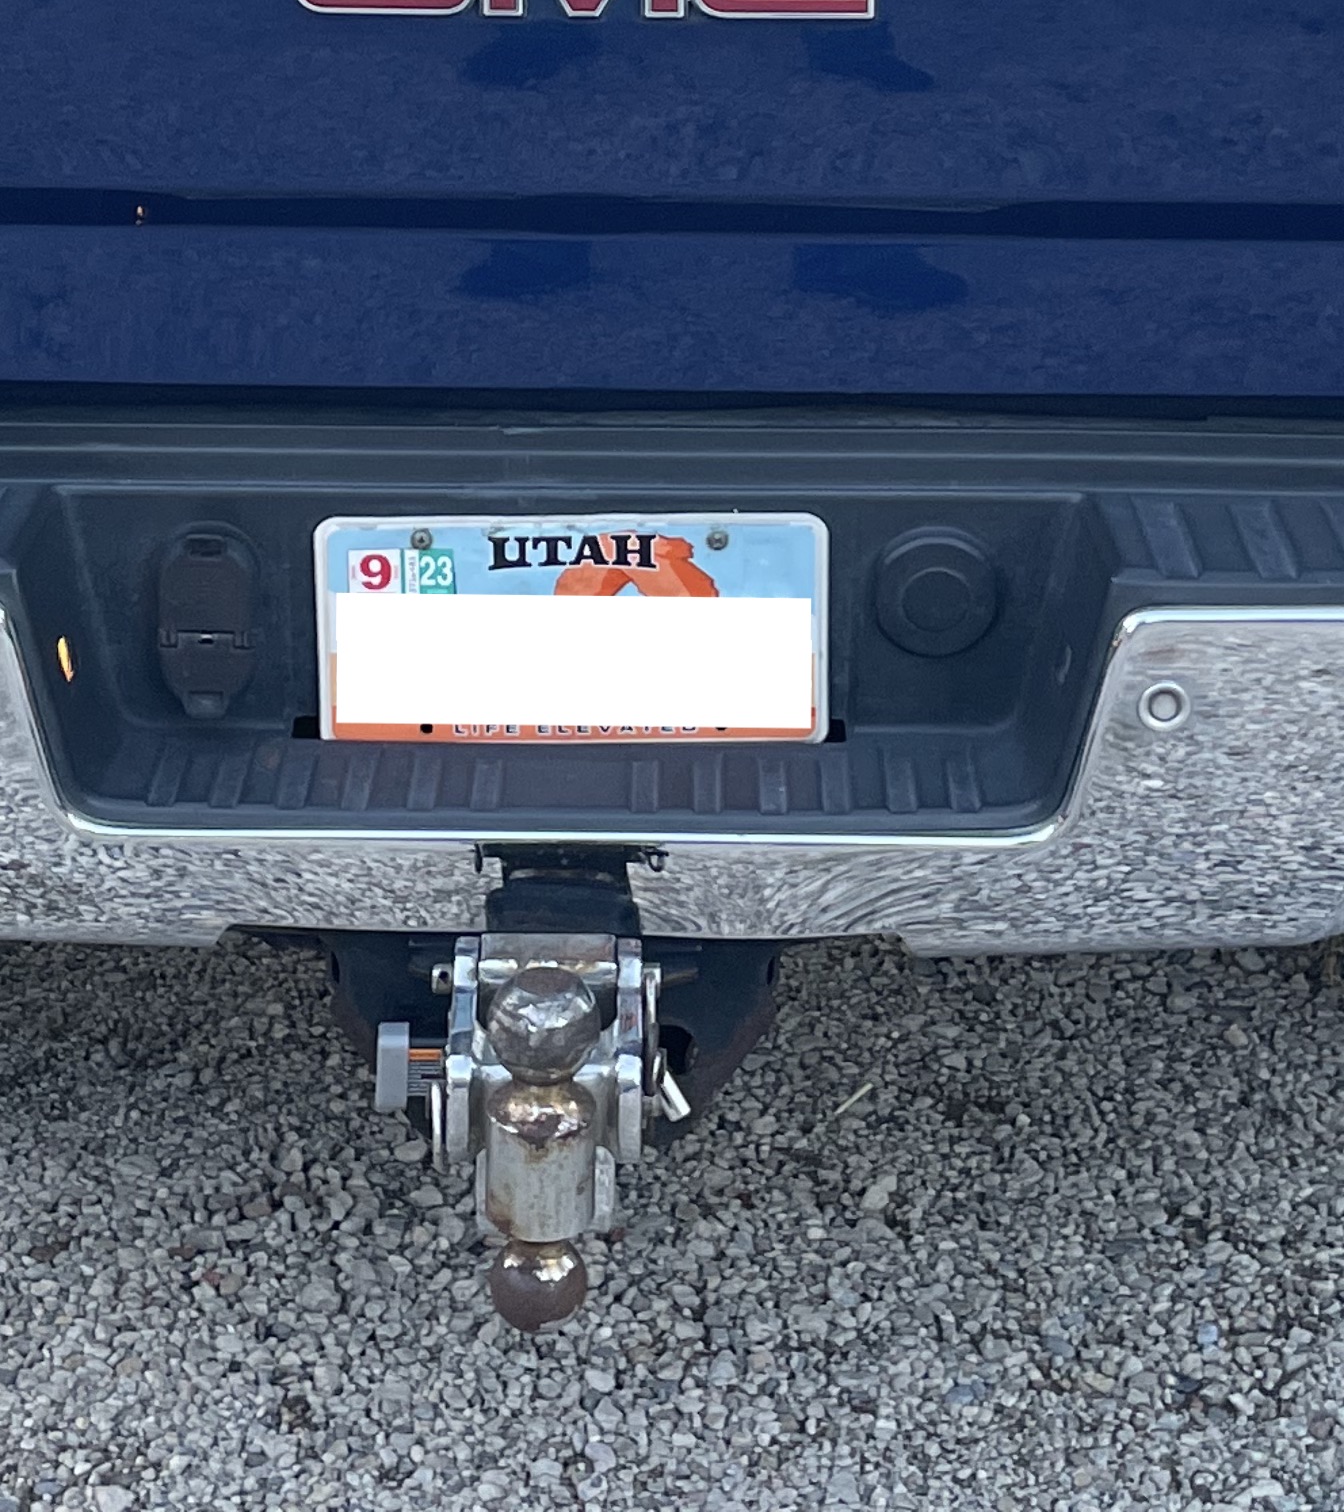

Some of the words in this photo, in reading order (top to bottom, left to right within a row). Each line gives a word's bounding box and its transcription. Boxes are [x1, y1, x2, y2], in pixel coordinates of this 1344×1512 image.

[419, 555, 453, 586] 23
[488, 534, 658, 571] UTAH
[359, 554, 392, 590] 9
